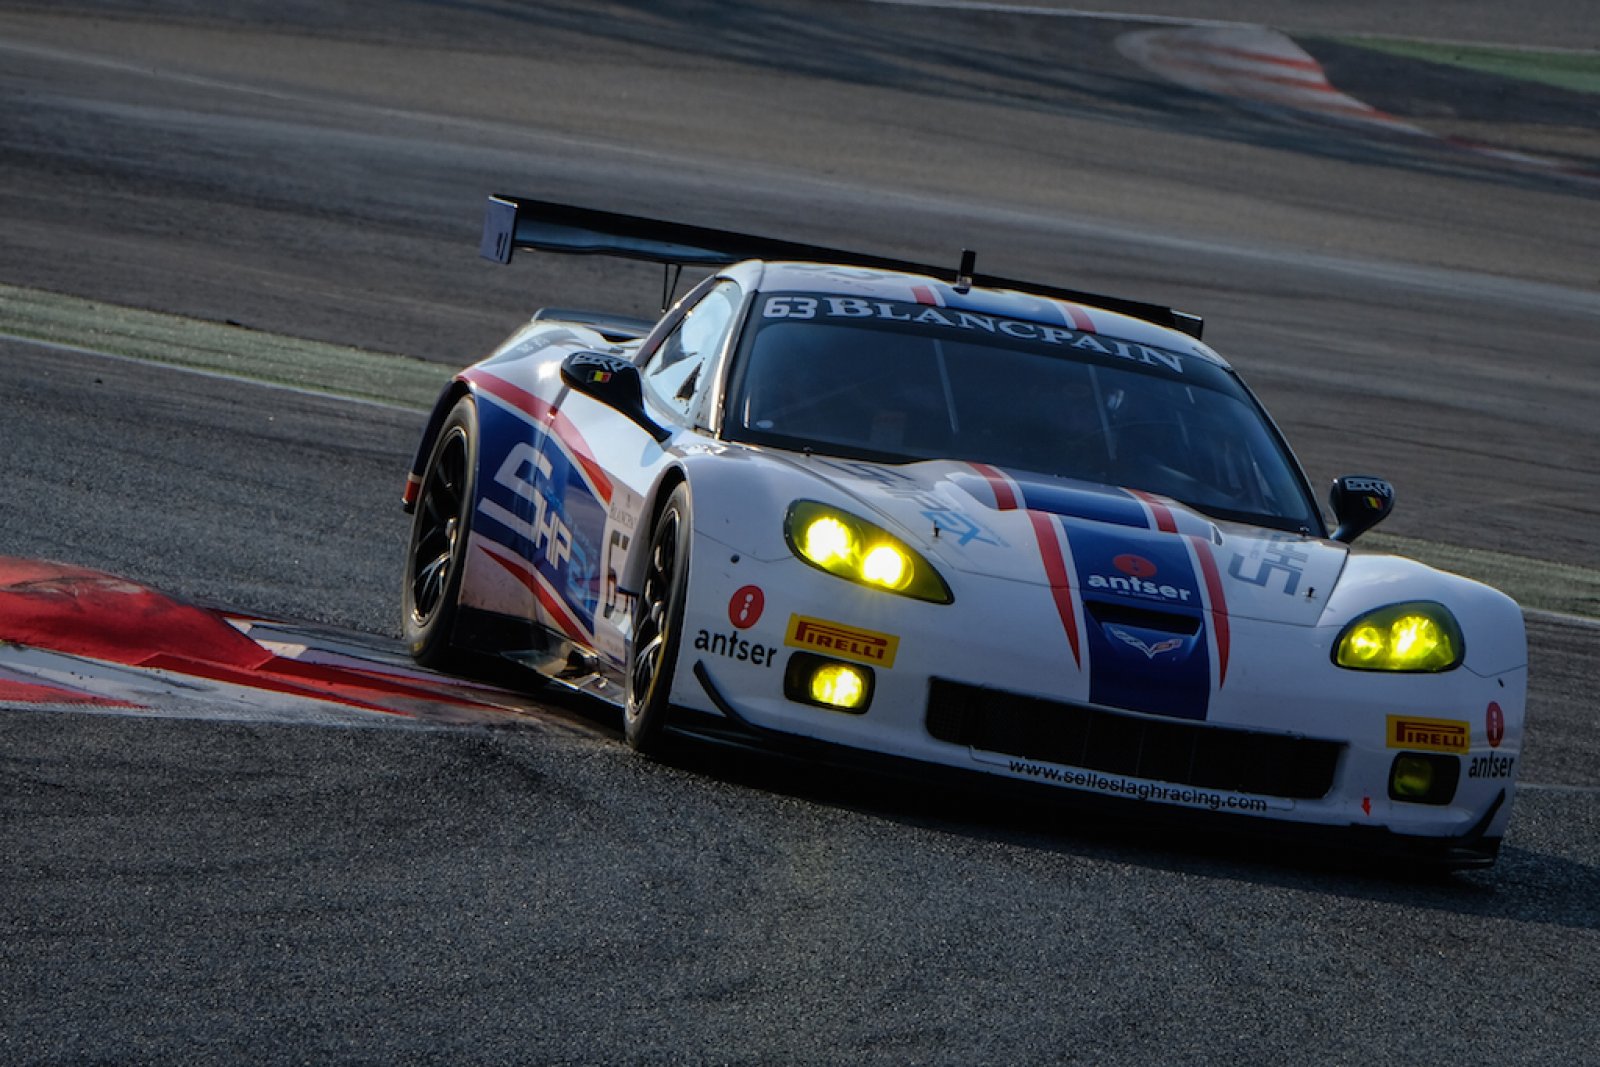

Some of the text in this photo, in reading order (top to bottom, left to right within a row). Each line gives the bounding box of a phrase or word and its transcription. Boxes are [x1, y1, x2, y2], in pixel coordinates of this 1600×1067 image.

[763, 296, 1184, 374] 63 BLANCPAIN
[1087, 574, 1191, 601] antser
[694, 629, 777, 668] antser
[795, 621, 888, 660] PIRELLI
[1396, 720, 1465, 747] PIRELLI
[1468, 751, 1515, 779] antser
[1008, 759, 1268, 812] www.selleslaghracing.com
